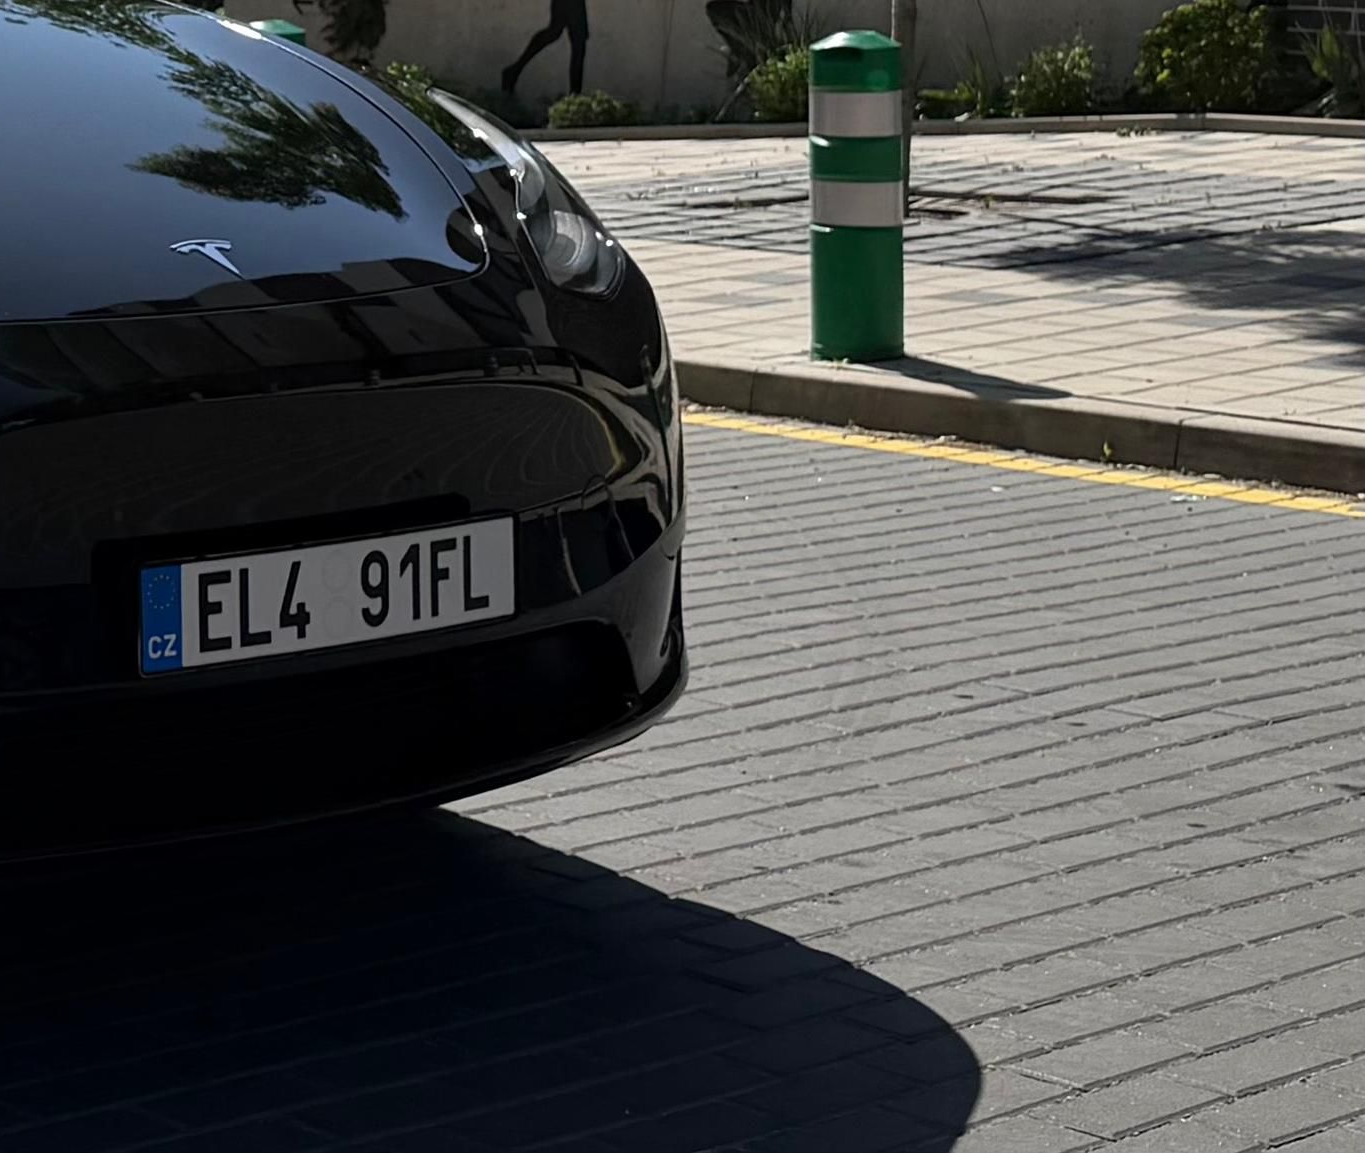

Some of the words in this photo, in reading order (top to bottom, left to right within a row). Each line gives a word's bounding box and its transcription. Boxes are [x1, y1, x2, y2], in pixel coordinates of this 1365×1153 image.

[198, 560, 311, 654] EL4
[360, 534, 491, 628] 91FL
[148, 634, 178, 660] CZ
